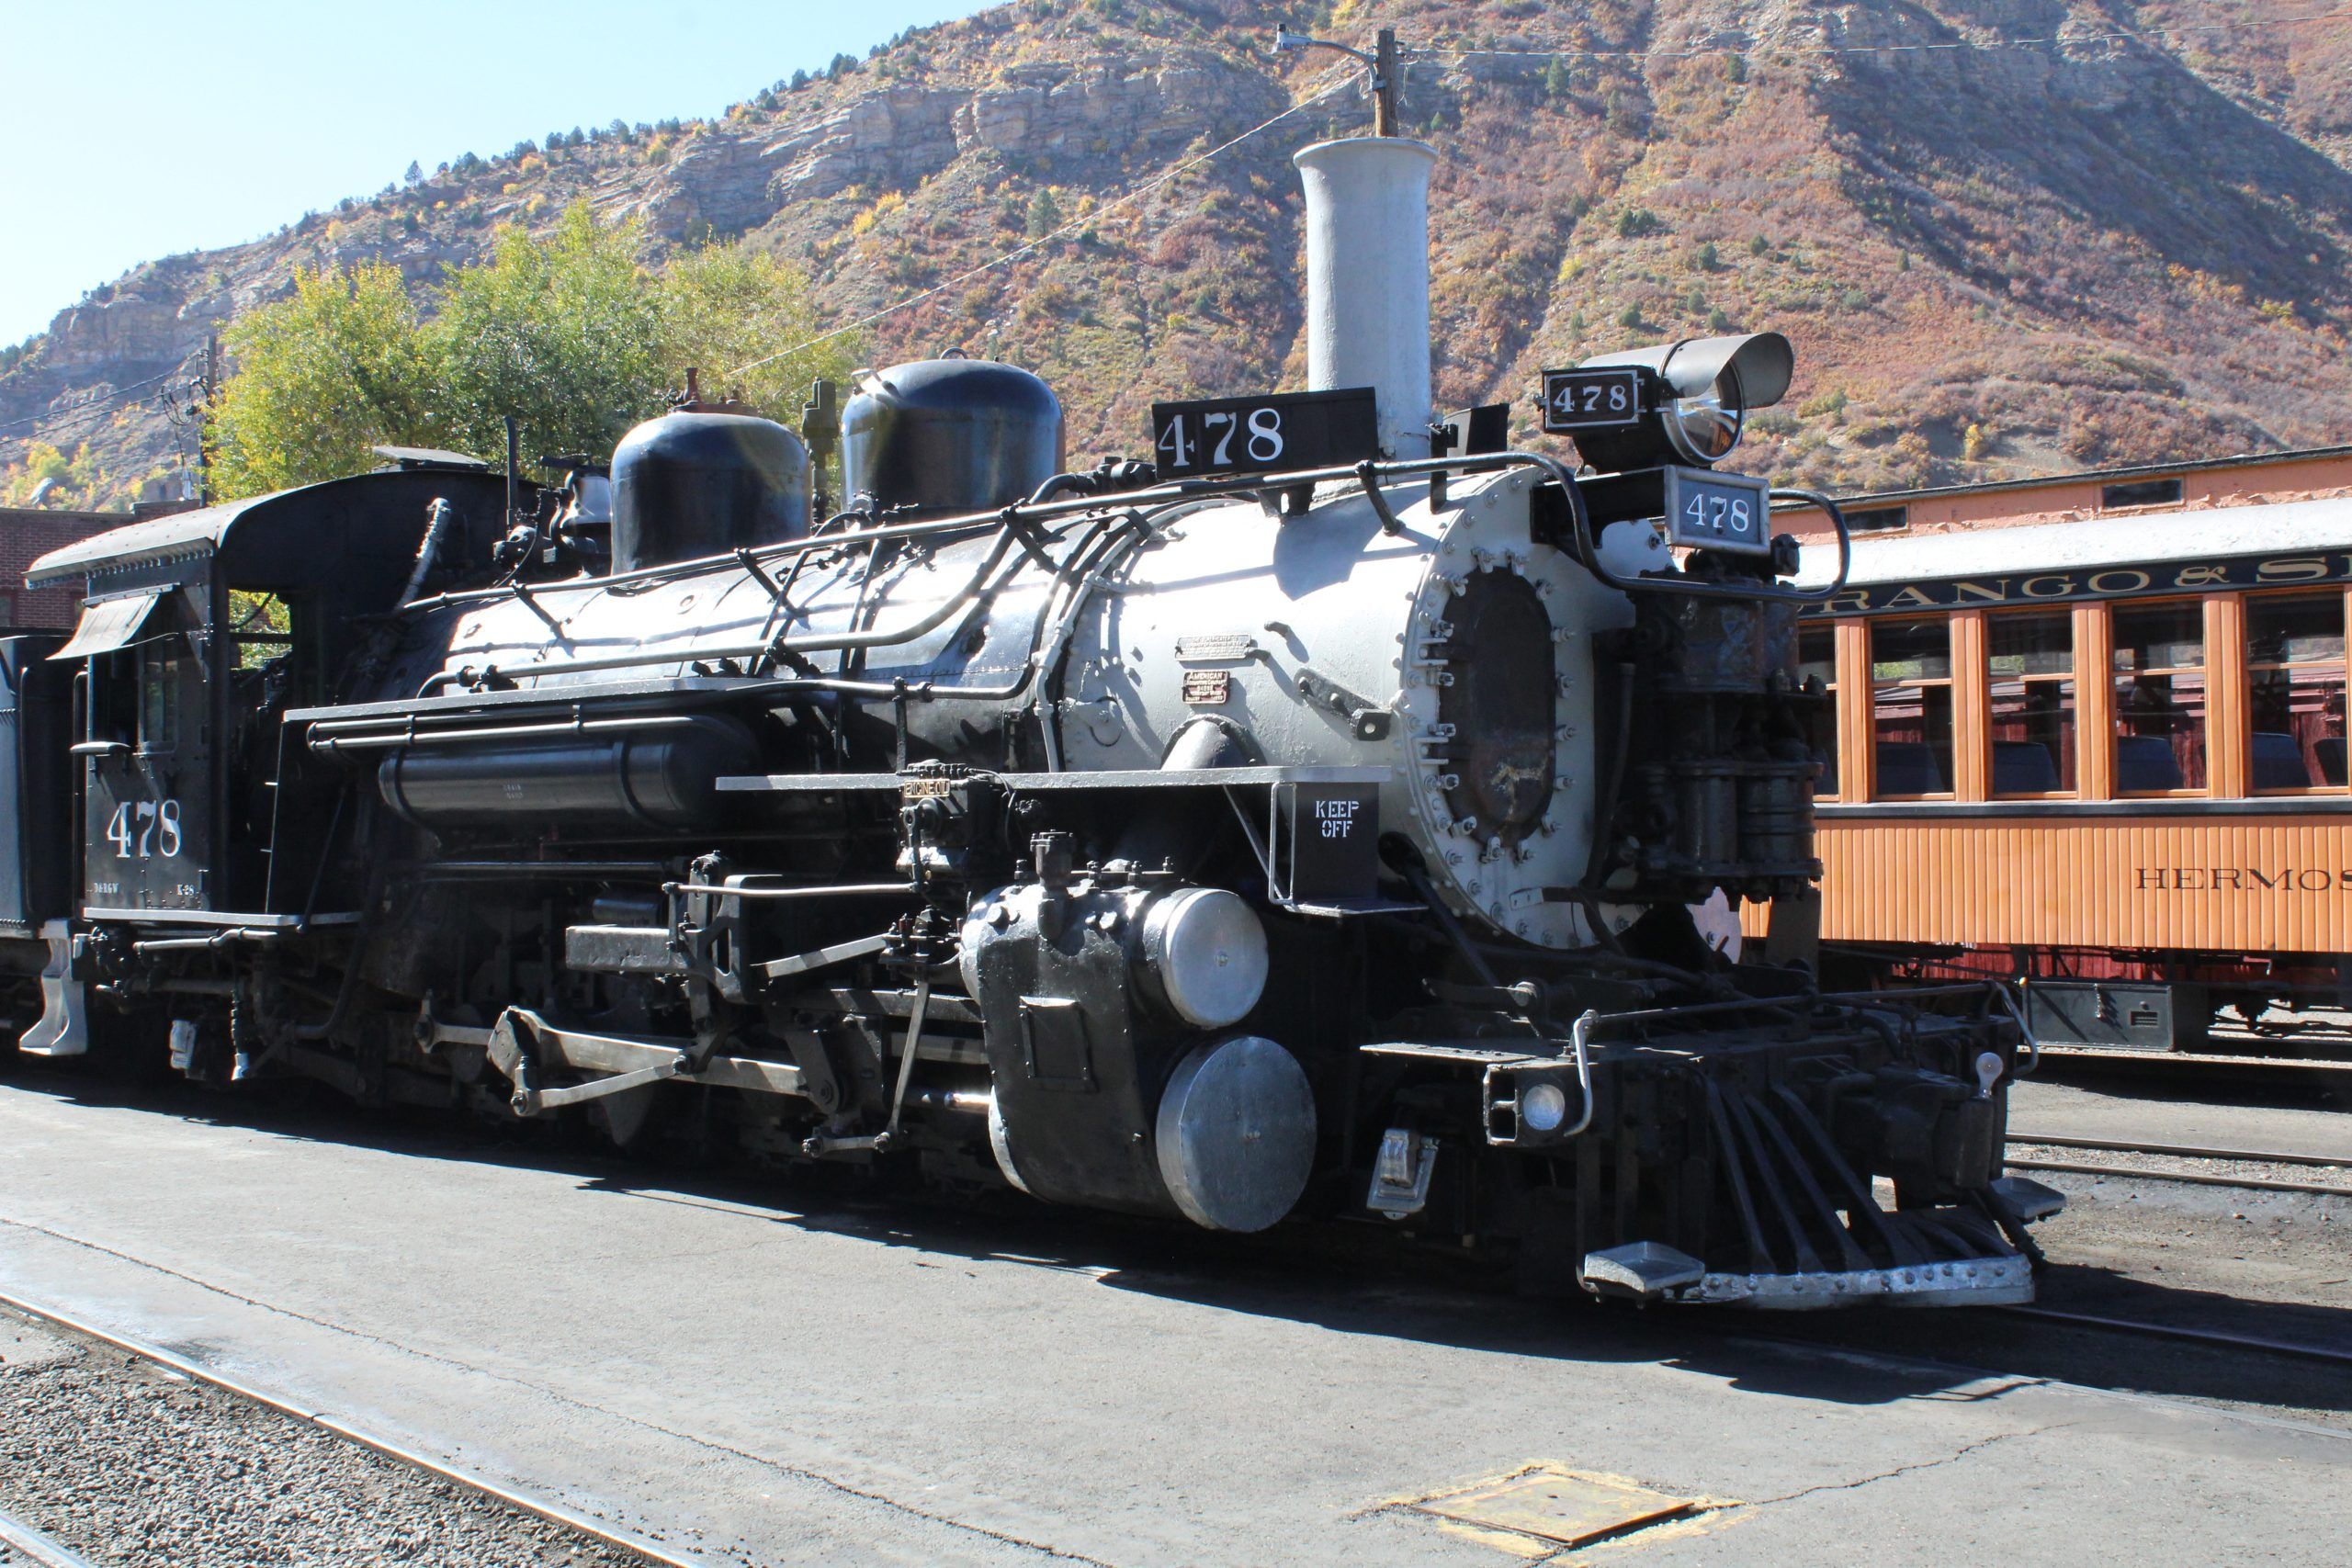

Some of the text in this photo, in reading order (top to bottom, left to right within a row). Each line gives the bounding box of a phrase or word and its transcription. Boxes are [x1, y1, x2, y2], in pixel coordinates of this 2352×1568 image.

[1553, 384, 1627, 412] 478
[1158, 408, 1283, 467] 478
[1686, 493, 1749, 532] 478
[1798, 570, 2151, 614] RANGO
[2174, 566, 2230, 587] &
[1188, 671, 1224, 681] AMERICAN
[905, 780, 950, 795] ENGINE OIL
[1316, 800, 1360, 818] KEEP
[107, 799, 181, 858] 478
[1321, 819, 1353, 838] OFF
